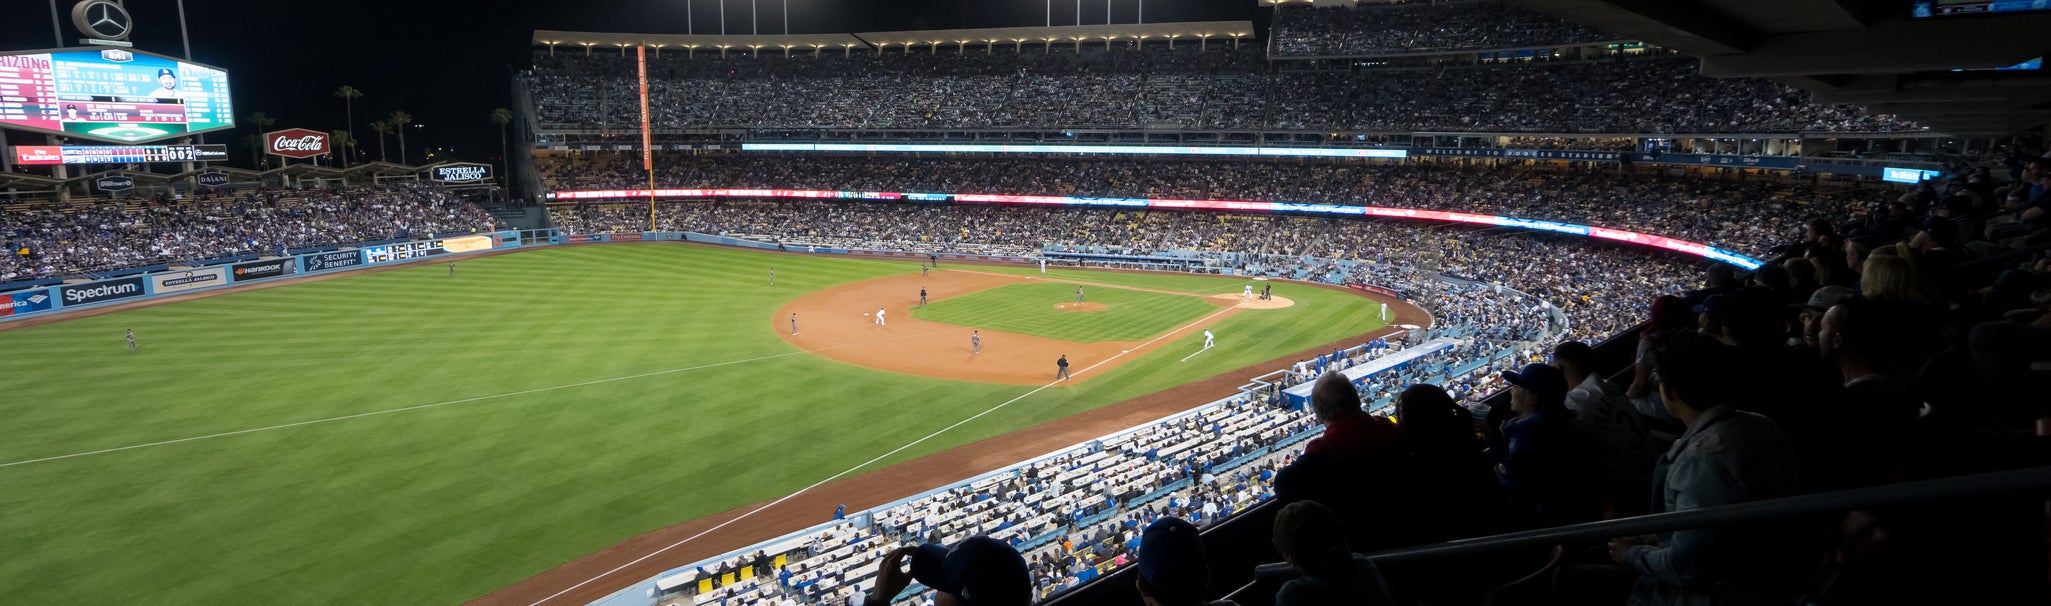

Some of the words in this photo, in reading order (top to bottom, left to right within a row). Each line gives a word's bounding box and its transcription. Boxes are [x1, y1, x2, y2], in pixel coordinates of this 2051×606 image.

[274, 135, 324, 151] Coca-Cola
[169, 150, 177, 160] 0
[178, 150, 185, 160] 0
[185, 150, 194, 160] 2
[439, 166, 486, 175] ESTRELLA
[201, 175, 227, 183] DASANI
[324, 252, 357, 261] SECURITY
[66, 283, 136, 302] Spectrum
